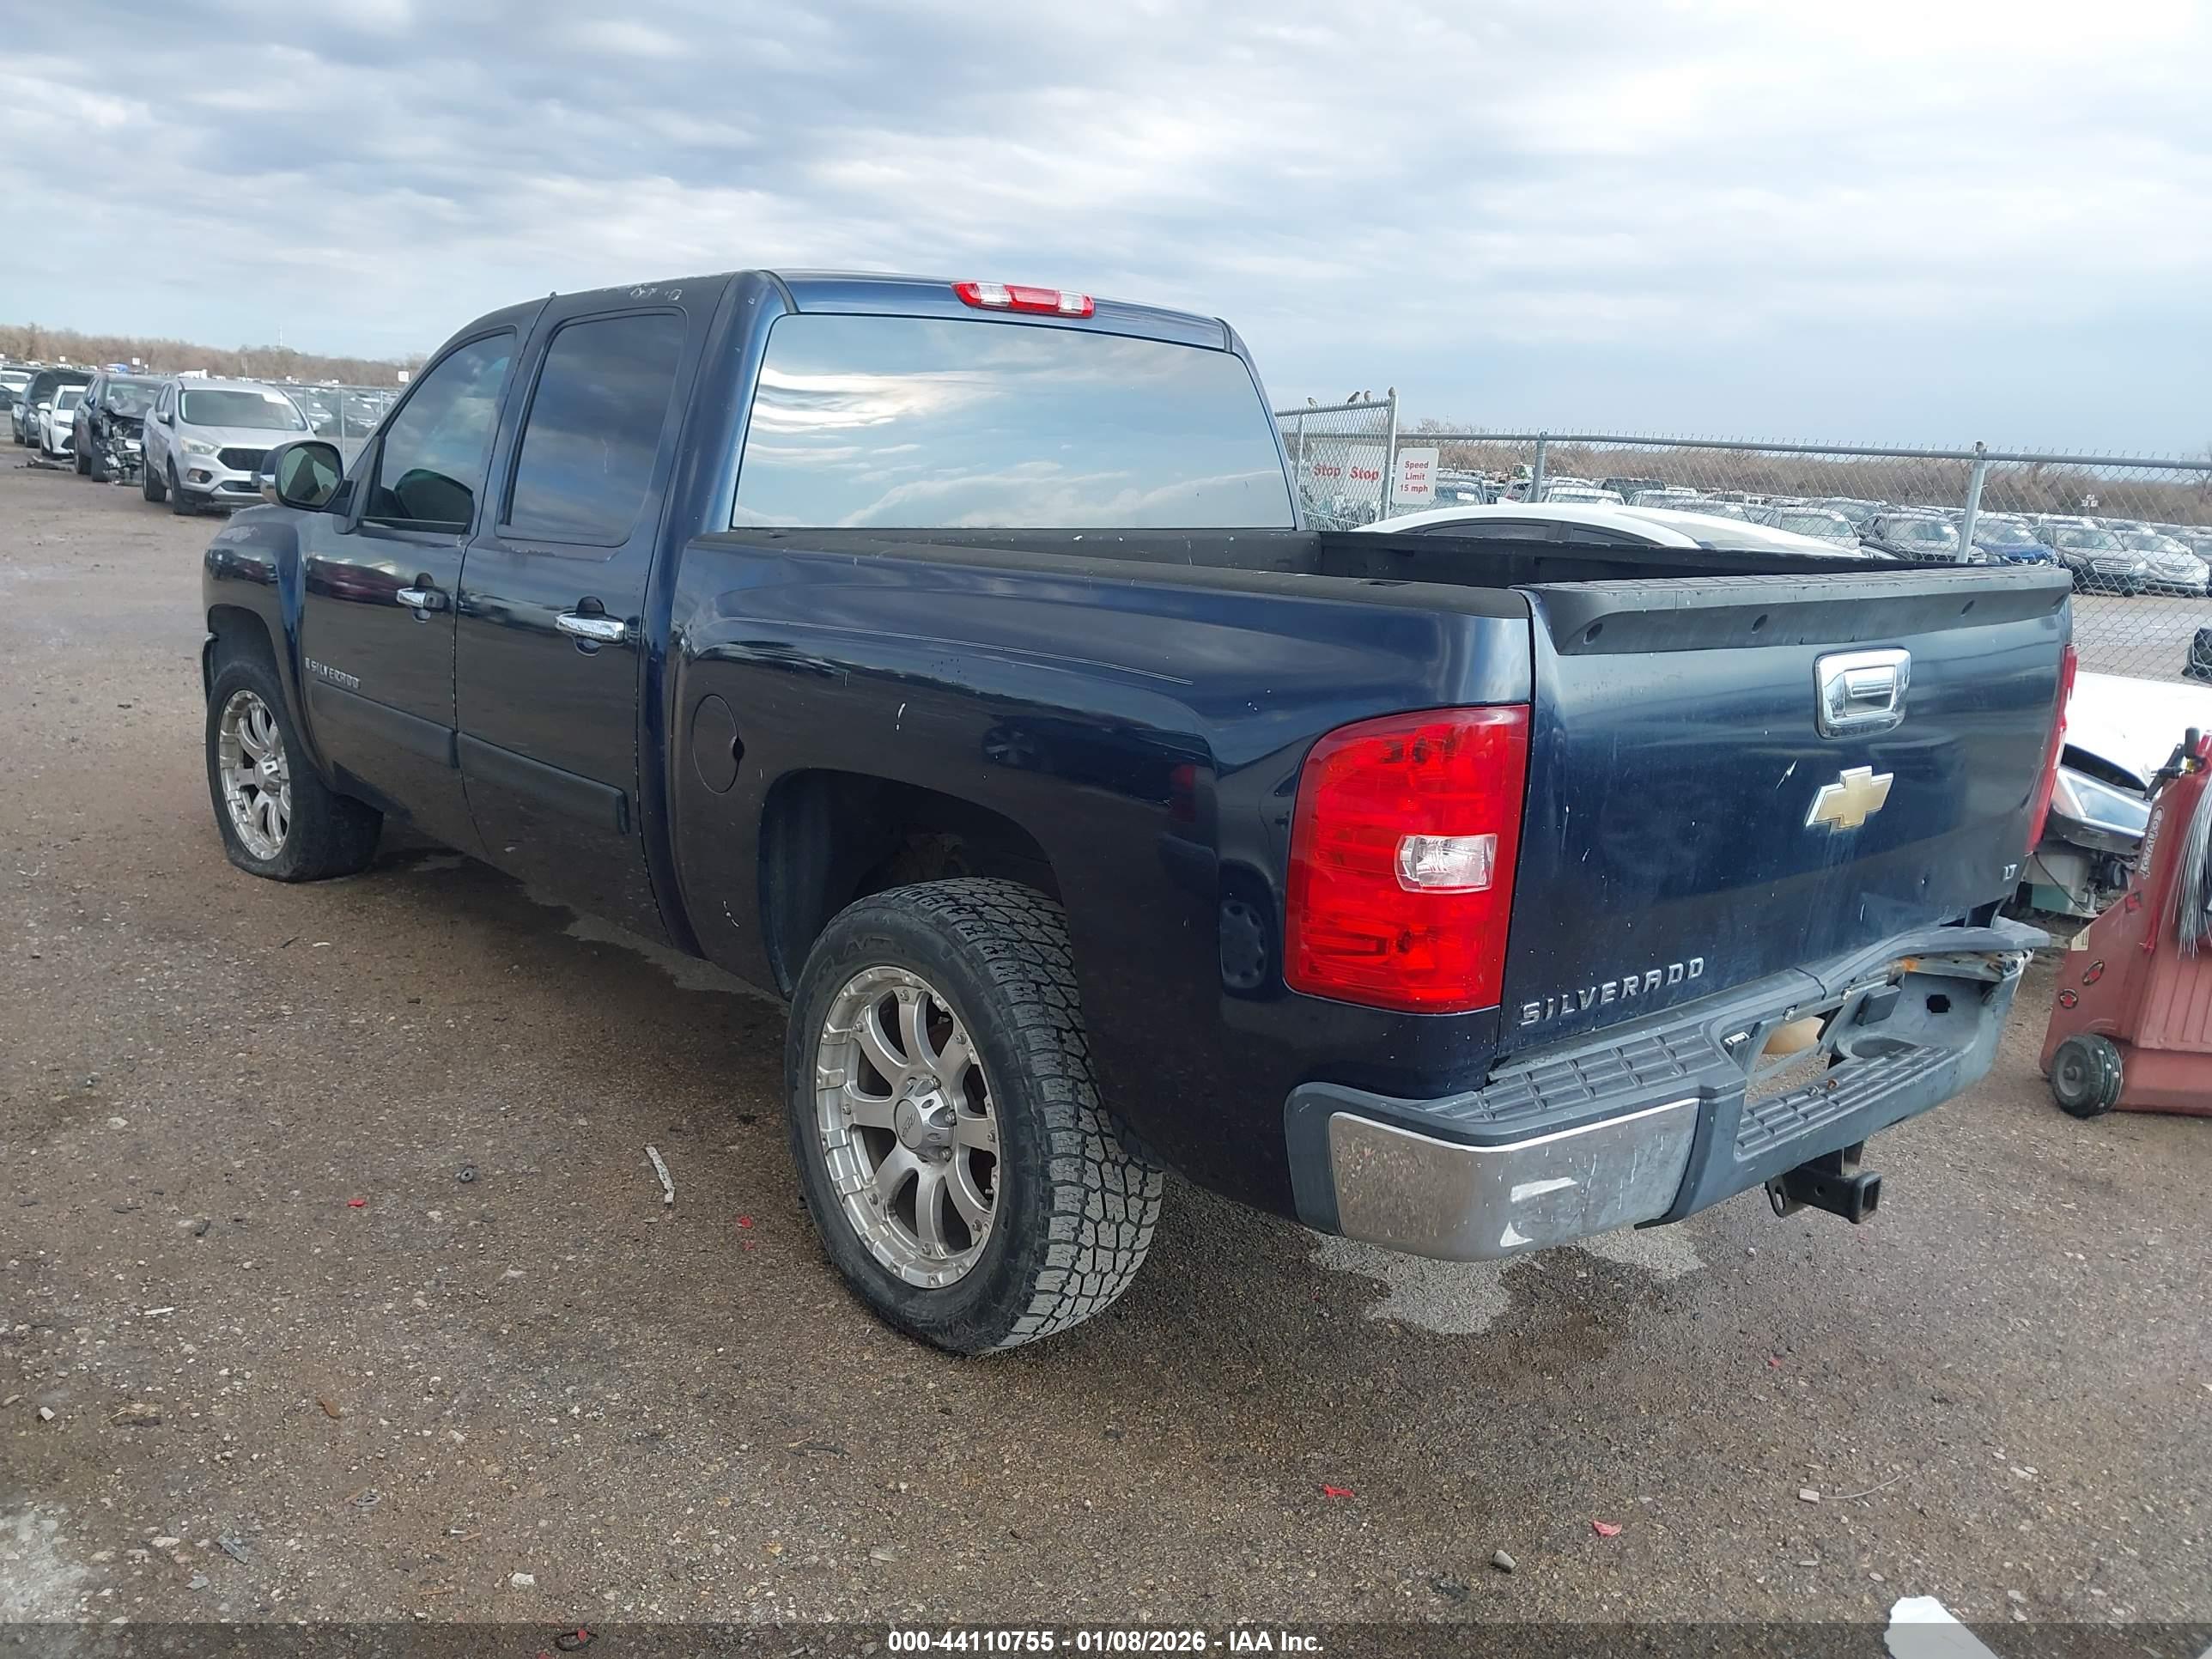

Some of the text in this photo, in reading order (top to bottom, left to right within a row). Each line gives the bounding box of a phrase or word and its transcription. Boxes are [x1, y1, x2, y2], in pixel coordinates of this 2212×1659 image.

[1314, 464, 1341, 478] Stop
[1404, 460, 1430, 471] Speed
[1349, 465, 1380, 482] Stop
[1405, 472, 1426, 481] Limit
[1401, 483, 1429, 495] 15 mph
[2002, 863, 2018, 882] LT
[1519, 956, 1705, 1027] SILVERADO
